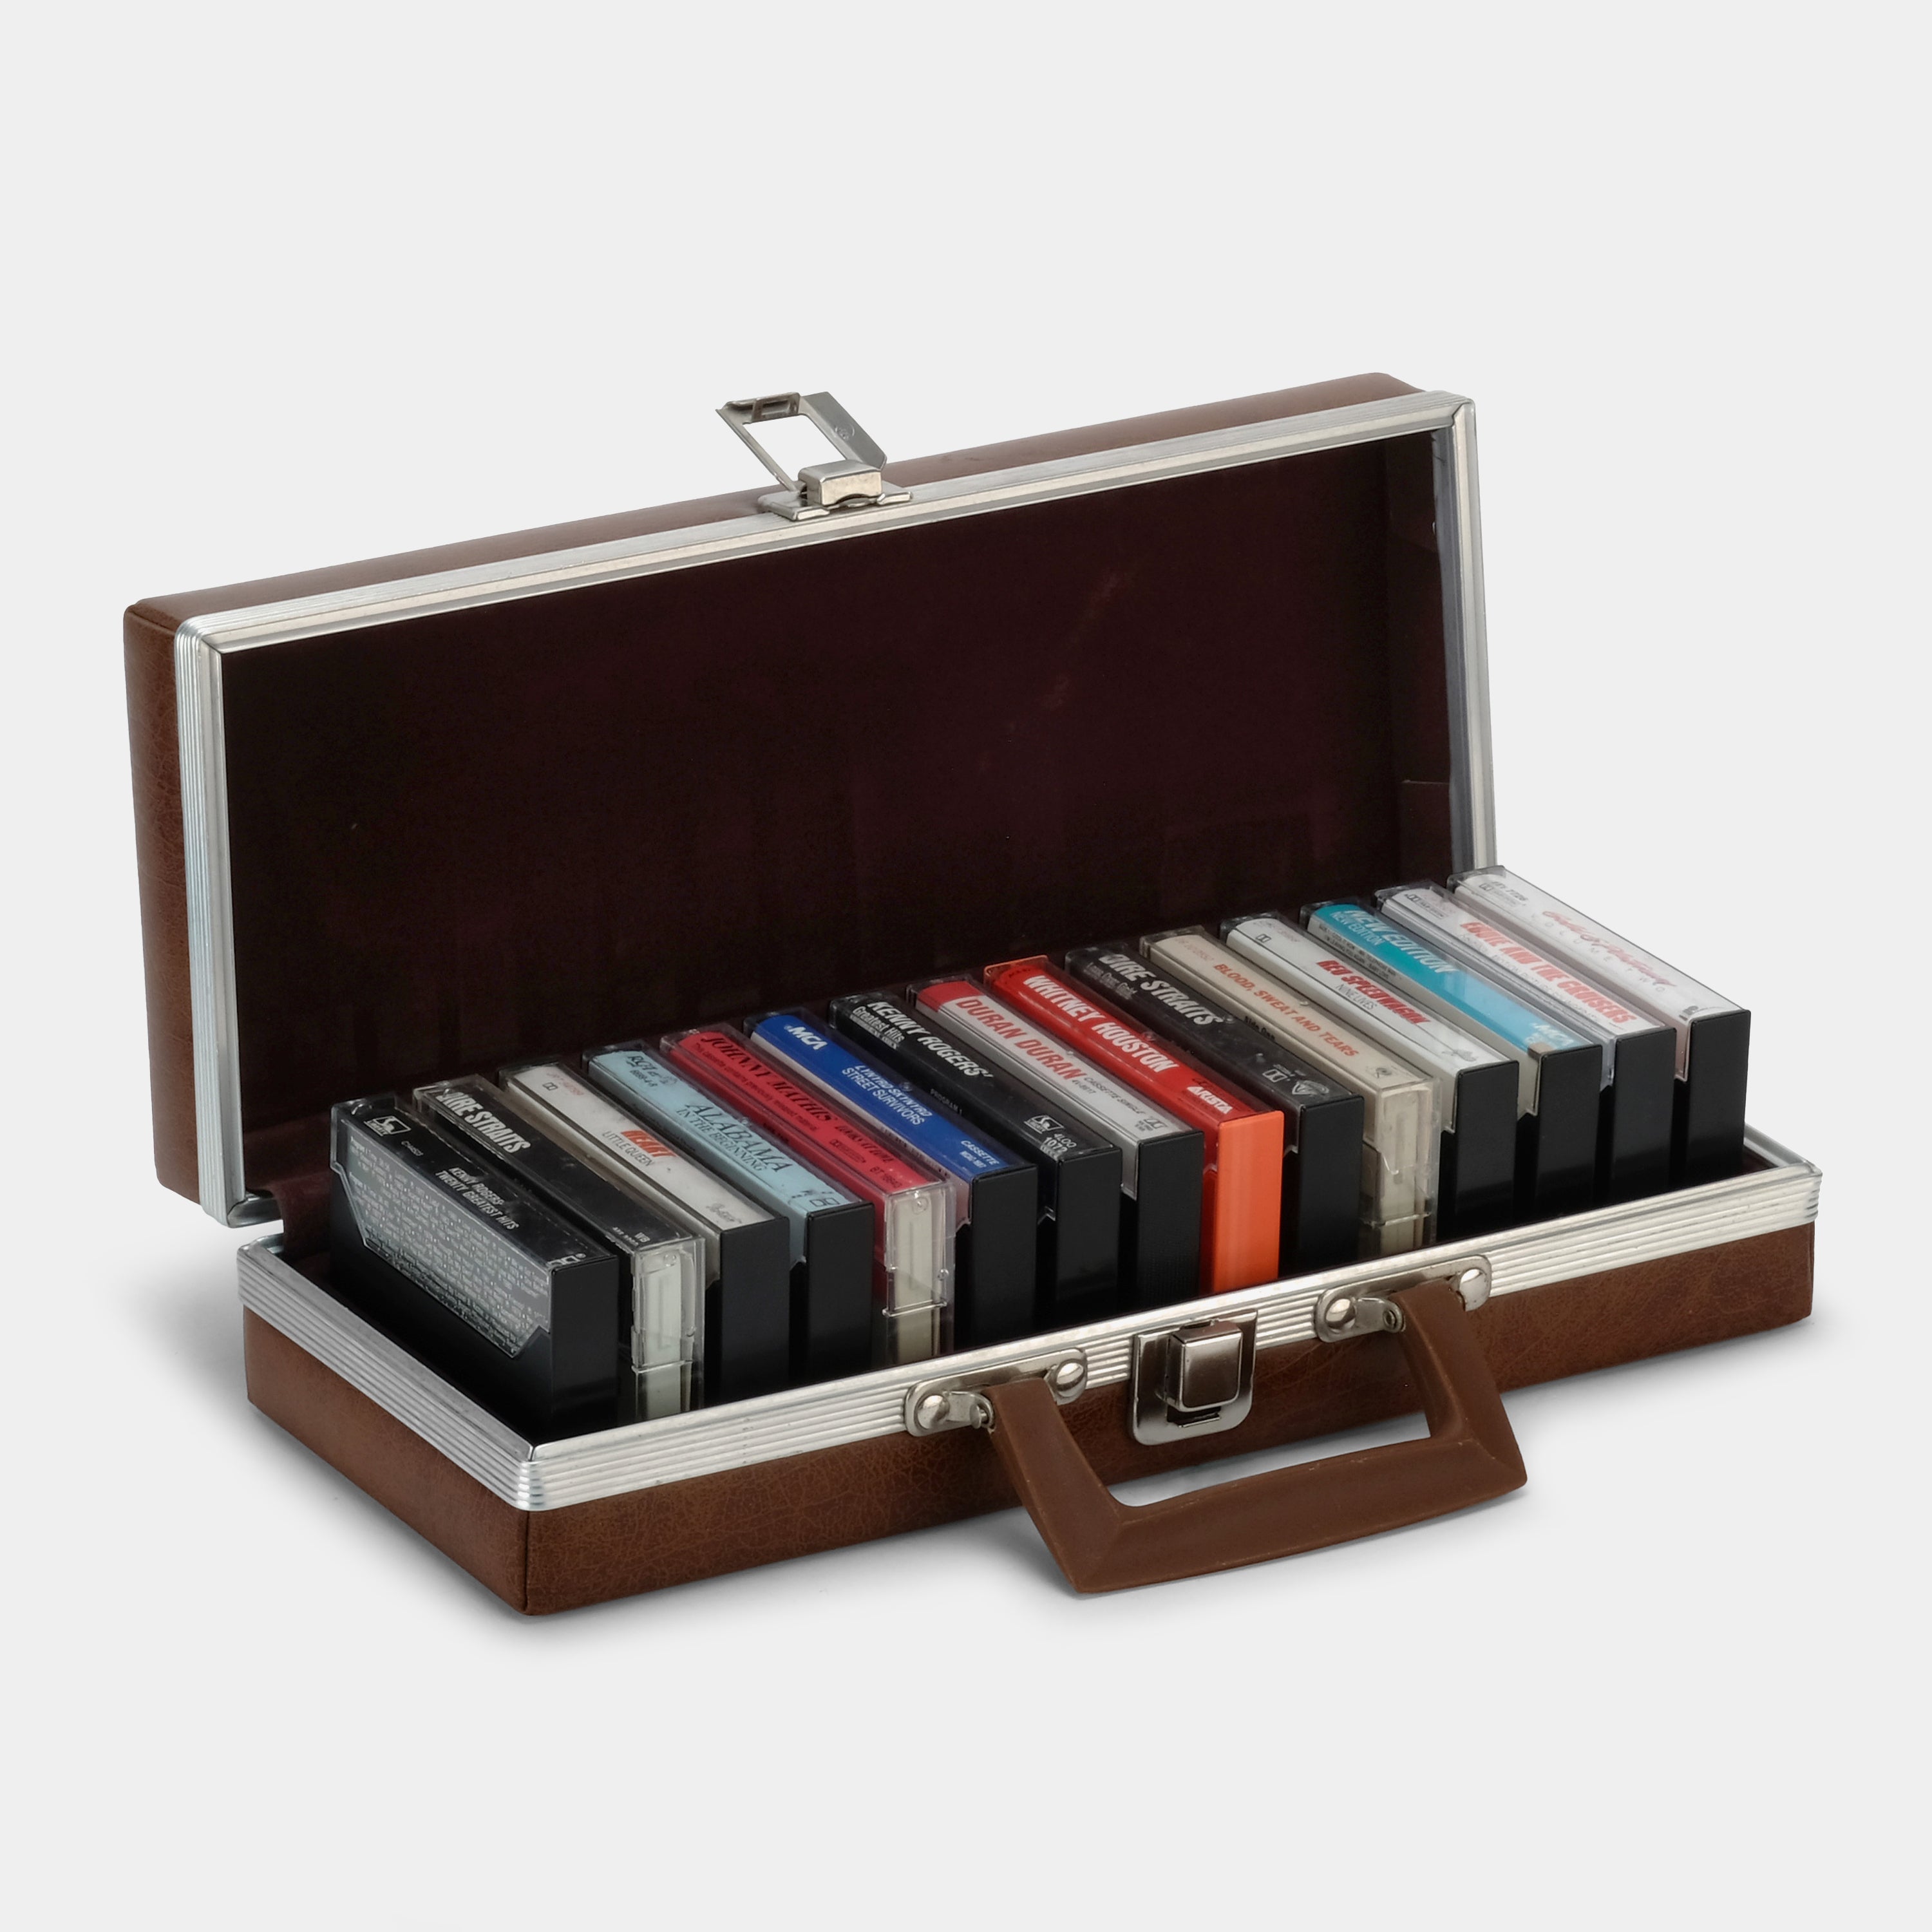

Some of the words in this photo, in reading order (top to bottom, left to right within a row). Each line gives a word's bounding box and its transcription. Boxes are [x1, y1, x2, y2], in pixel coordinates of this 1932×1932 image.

[1330, 911, 1351, 925] NEW
[1348, 922, 1386, 945] EDITION
[1345, 910, 1399, 935] NEW
[1381, 932, 1461, 974] EDITION
[1098, 953, 1157, 983] DIRE
[1140, 980, 1224, 1027] STRAITS
[1213, 963, 1256, 993] BLOOD,
[1253, 987, 1298, 1017] SWEAT
[1294, 1009, 1321, 1034] AND
[1318, 1030, 1359, 1057] TEARS
[1316, 960, 1354, 976] REO
[1341, 974, 1432, 1026] SPEEDWAGON
[1334, 983, 1358, 999] NINE
[1351, 994, 1378, 1011] LIVES
[1531, 963, 1569, 981] THE
[1557, 980, 1637, 1025] CRUISERS
[787, 1026, 829, 1051] MCA
[852, 1006, 890, 1032] Greatest
[884, 1027, 905, 1043] Hits
[867, 1001, 929, 1037] KENNY
[956, 996, 1022, 1039] DURAN
[1015, 1040, 1087, 1081] DURAN
[1023, 974, 1106, 1023] WHITNEY
[1091, 1022, 1180, 1074] HOUSTON
[701, 1037, 770, 1077] JOHNNY
[841, 1067, 876, 1094] STREET
[873, 1088, 925, 1126] SURVIVORS
[855, 1065, 895, 1090] LYNYRD
[888, 1085, 933, 1118] SKYNYRD
[1187, 1086, 1233, 1115] ARISTA
[464, 1110, 531, 1153] STRAITS
[602, 1130, 629, 1153] LITTLE
[624, 1146, 655, 1167] QUEEN
[676, 1108, 696, 1121] IN
[690, 1115, 714, 1133] THE
[708, 1128, 764, 1172] BEGINNING
[687, 1103, 794, 1174] ALABAMA
[960, 1139, 1000, 1165] CASSETTE
[435, 1170, 469, 1191] TWENTY
[462, 1191, 503, 1217] GREATEST
[496, 1215, 520, 1230] HITS
[449, 1167, 478, 1184] KENNY
